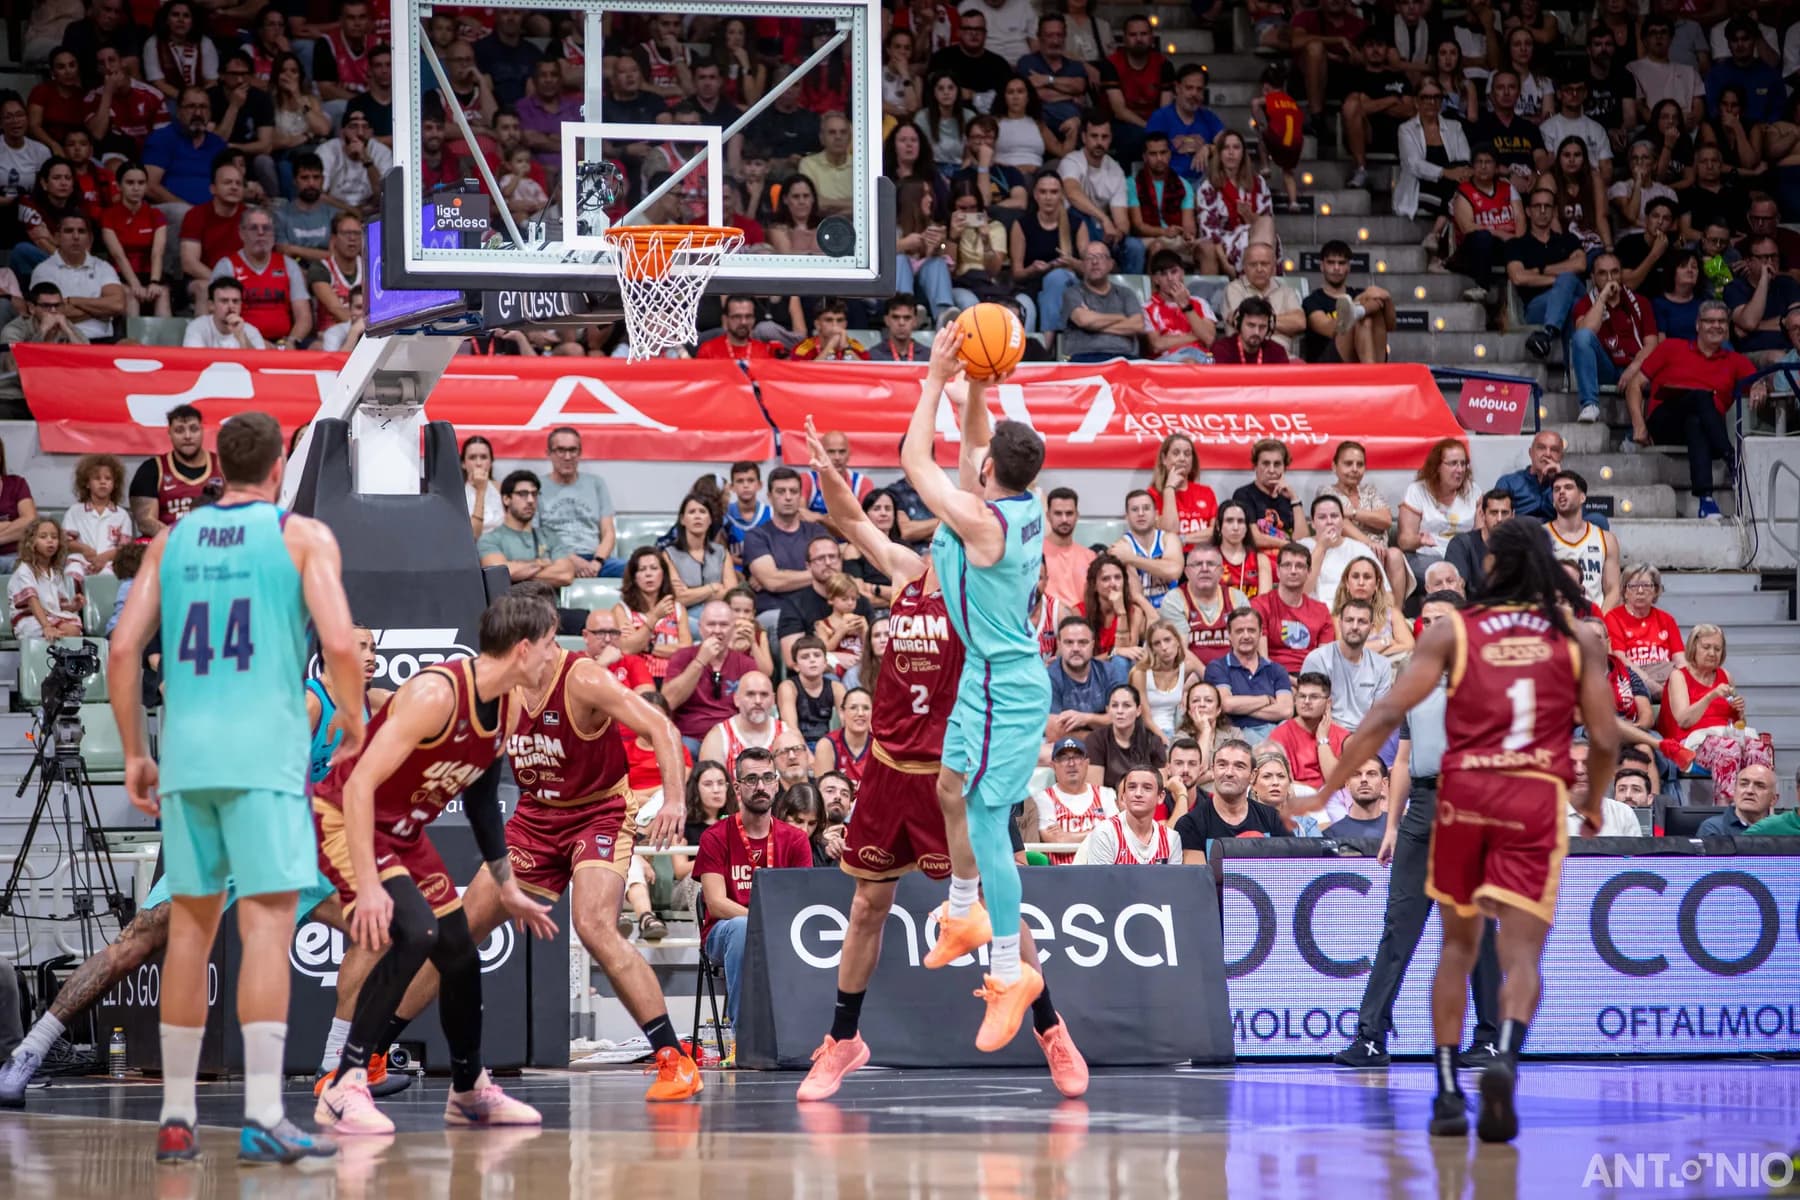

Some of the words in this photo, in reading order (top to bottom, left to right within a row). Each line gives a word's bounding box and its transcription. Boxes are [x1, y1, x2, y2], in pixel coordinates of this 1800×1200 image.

[1493, 136, 1532, 148] UCAM
[436, 205, 460, 218] liga
[437, 217, 488, 228] endesa
[1469, 396, 1517, 412] MÓDULO
[1124, 412, 1264, 433] AGENCIA
[1269, 413, 1313, 431] DE
[1486, 413, 1494, 423] 6
[198, 526, 245, 547] PARRA
[889, 615, 949, 640] UCAM
[178, 598, 254, 676] 44
[893, 639, 940, 654] MURCIA
[910, 684, 930, 714] 2
[1505, 678, 1537, 750] 1
[506, 733, 566, 759] UCAM
[514, 753, 562, 769] MURCIA
[862, 851, 892, 866] Juver
[1590, 870, 1800, 977] CO
